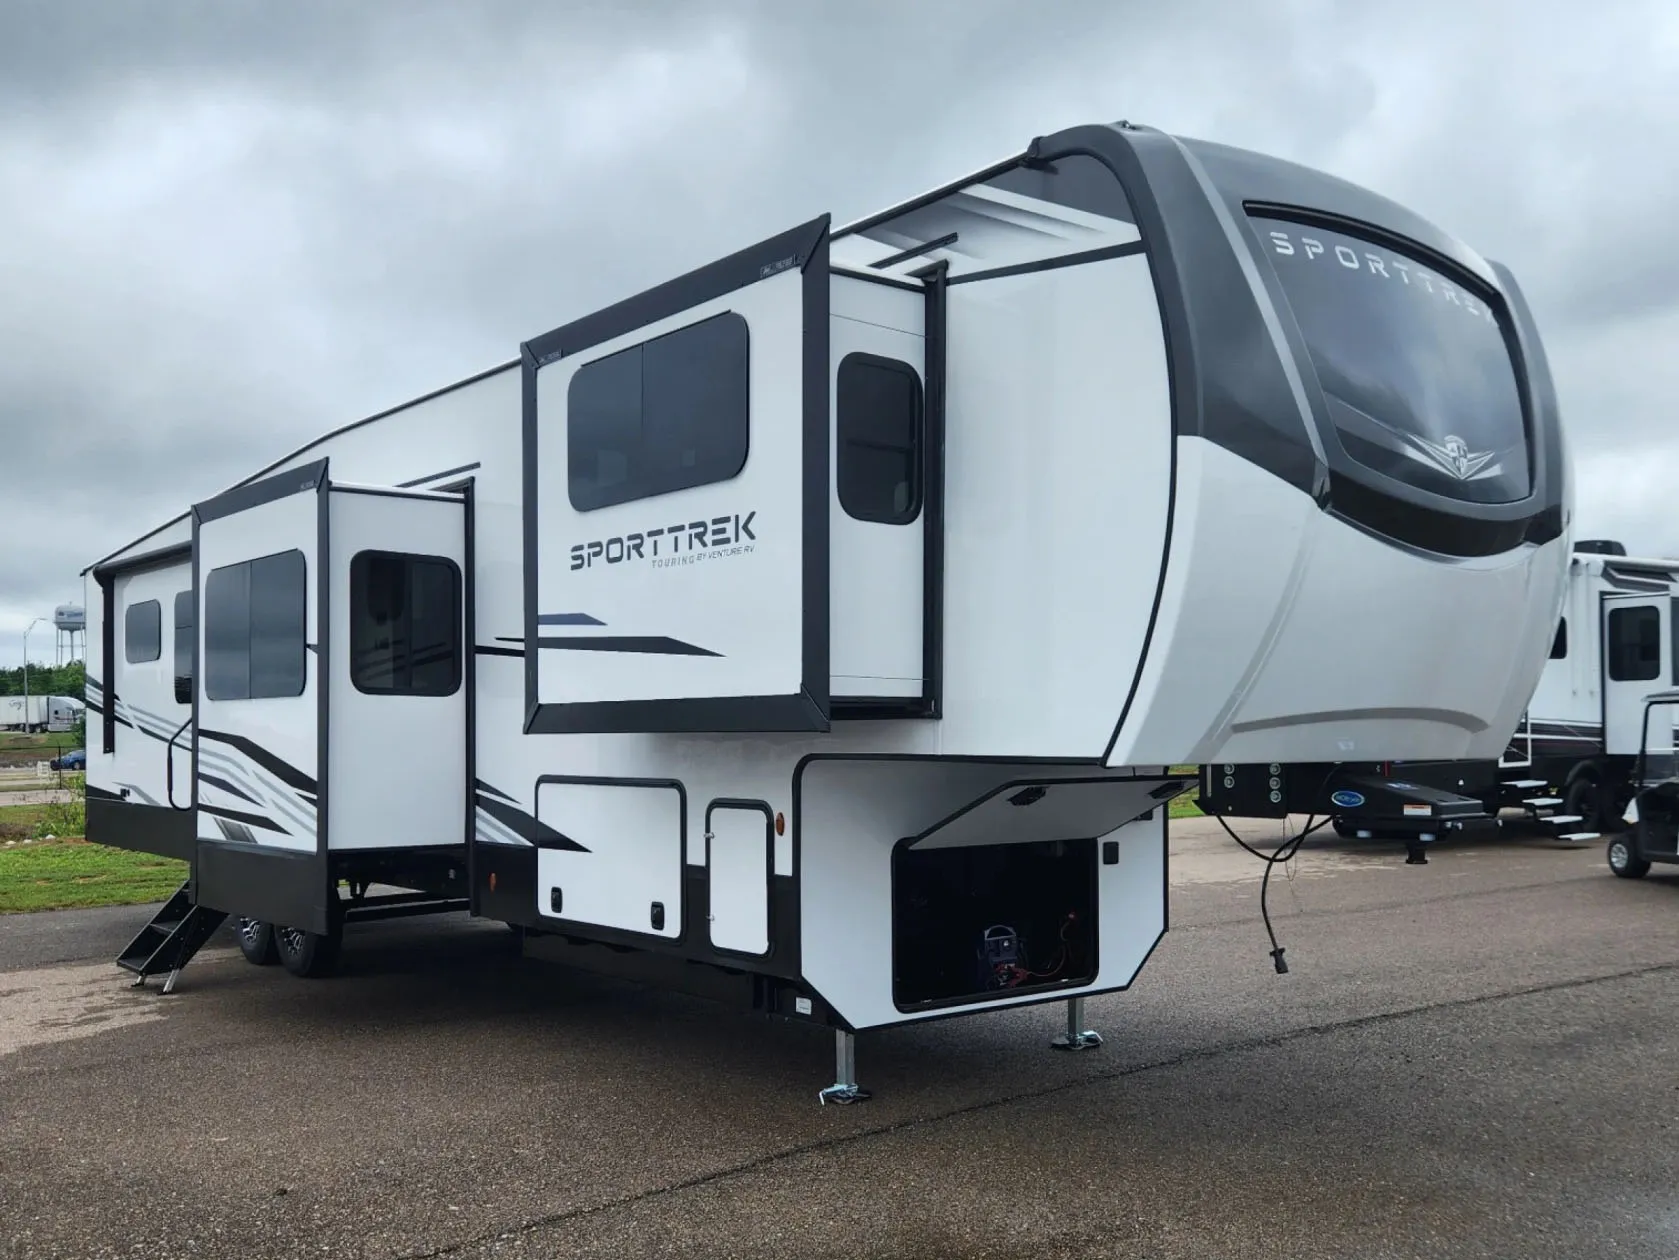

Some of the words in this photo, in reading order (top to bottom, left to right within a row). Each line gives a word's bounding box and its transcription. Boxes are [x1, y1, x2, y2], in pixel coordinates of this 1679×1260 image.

[570, 511, 756, 571] SPORTTREK
[651, 555, 695, 569] TOURING
[696, 552, 707, 561] BY
[708, 546, 743, 559] VENTURE
[743, 544, 755, 553] RV
